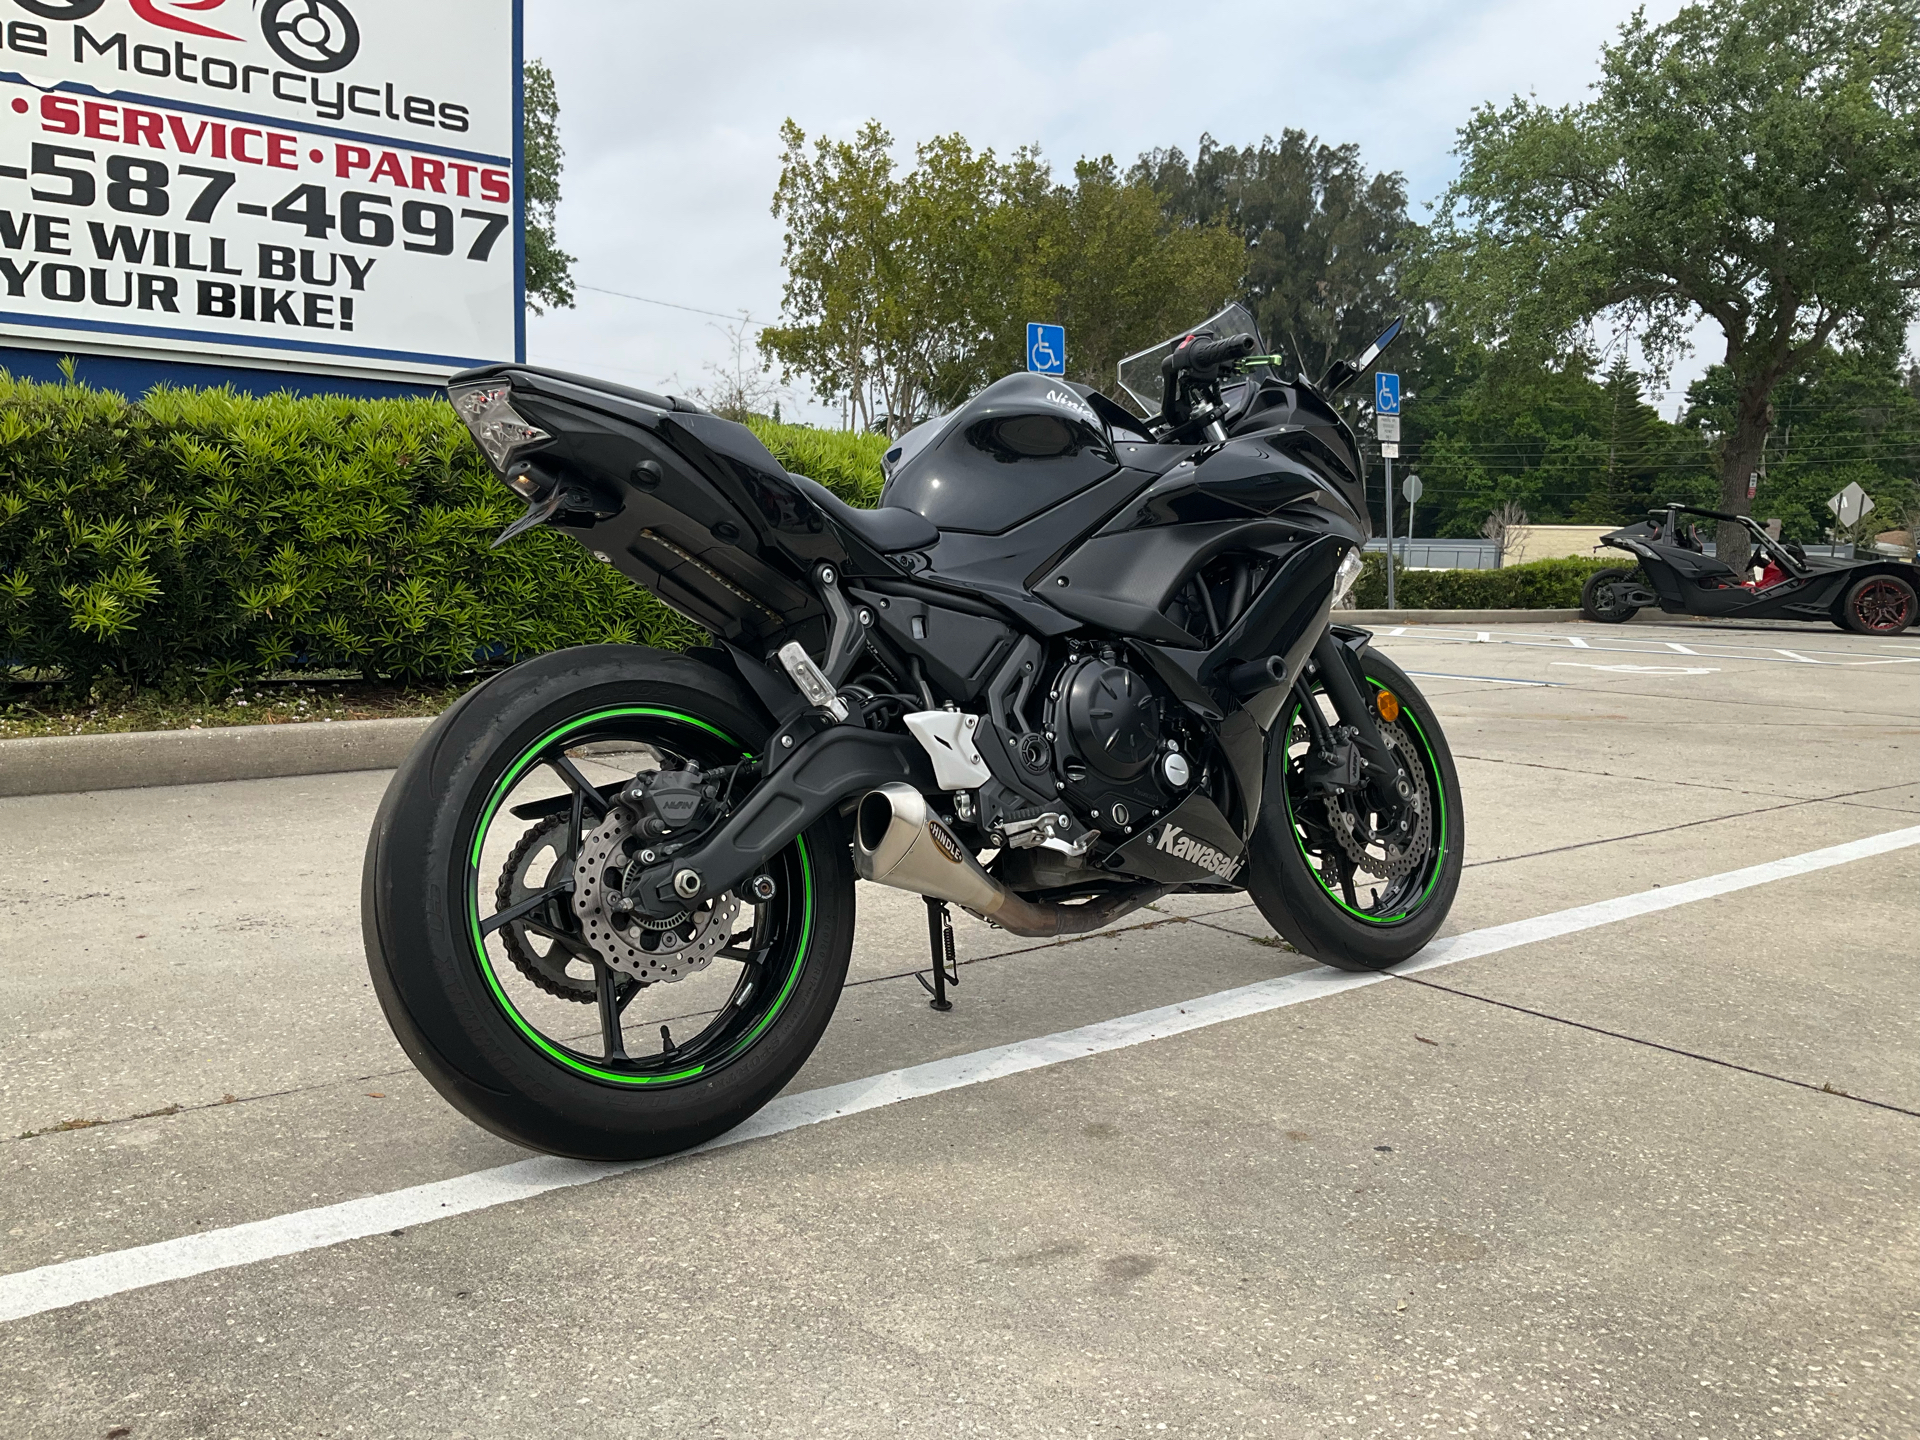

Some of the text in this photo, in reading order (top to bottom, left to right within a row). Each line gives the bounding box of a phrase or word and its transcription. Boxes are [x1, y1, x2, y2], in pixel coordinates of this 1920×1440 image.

[74, 24, 470, 132] Motorcycles
[40, 94, 510, 204] SERVICE PARTS
[0, 209, 377, 291] WE WILL BUY
[0, 256, 353, 332] YOUR BIKE!
[1046, 390, 1098, 423] Ninja
[932, 823, 960, 860] HINDLE
[1156, 822, 1246, 882] Kawasaki
